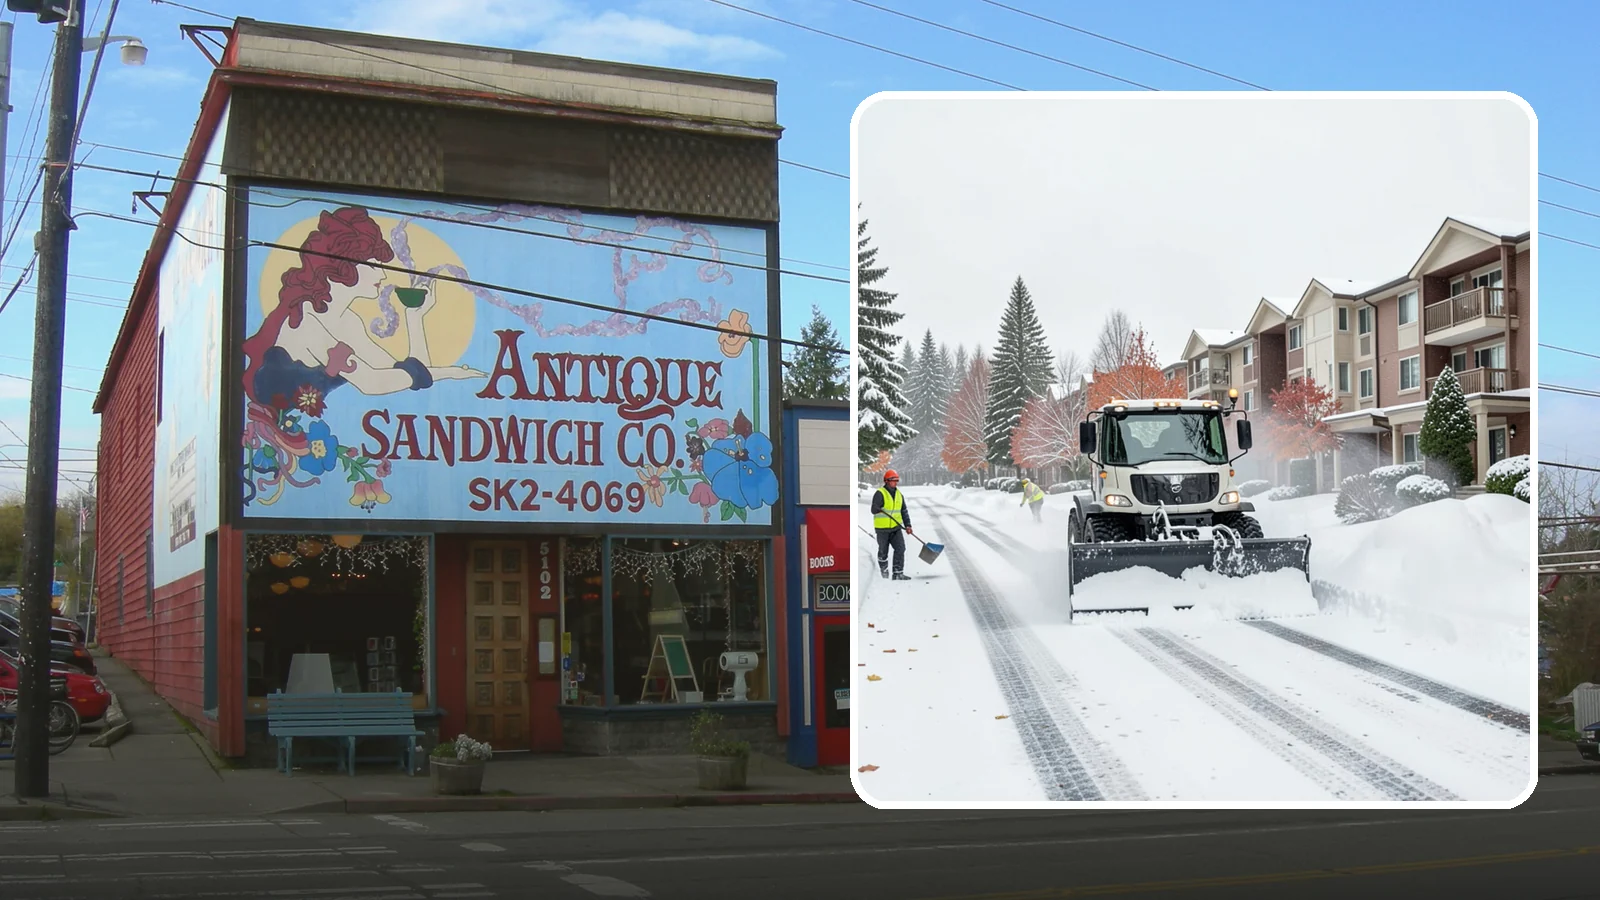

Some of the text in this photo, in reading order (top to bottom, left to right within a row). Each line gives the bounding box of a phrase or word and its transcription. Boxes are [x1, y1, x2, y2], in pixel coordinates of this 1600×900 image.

[475, 329, 723, 421] ANTIQUE
[361, 408, 684, 469] SANDWICH CO.
[468, 477, 645, 513] SK2-4069
[540, 542, 551, 599] 5102
[809, 555, 834, 568] BOOKS
